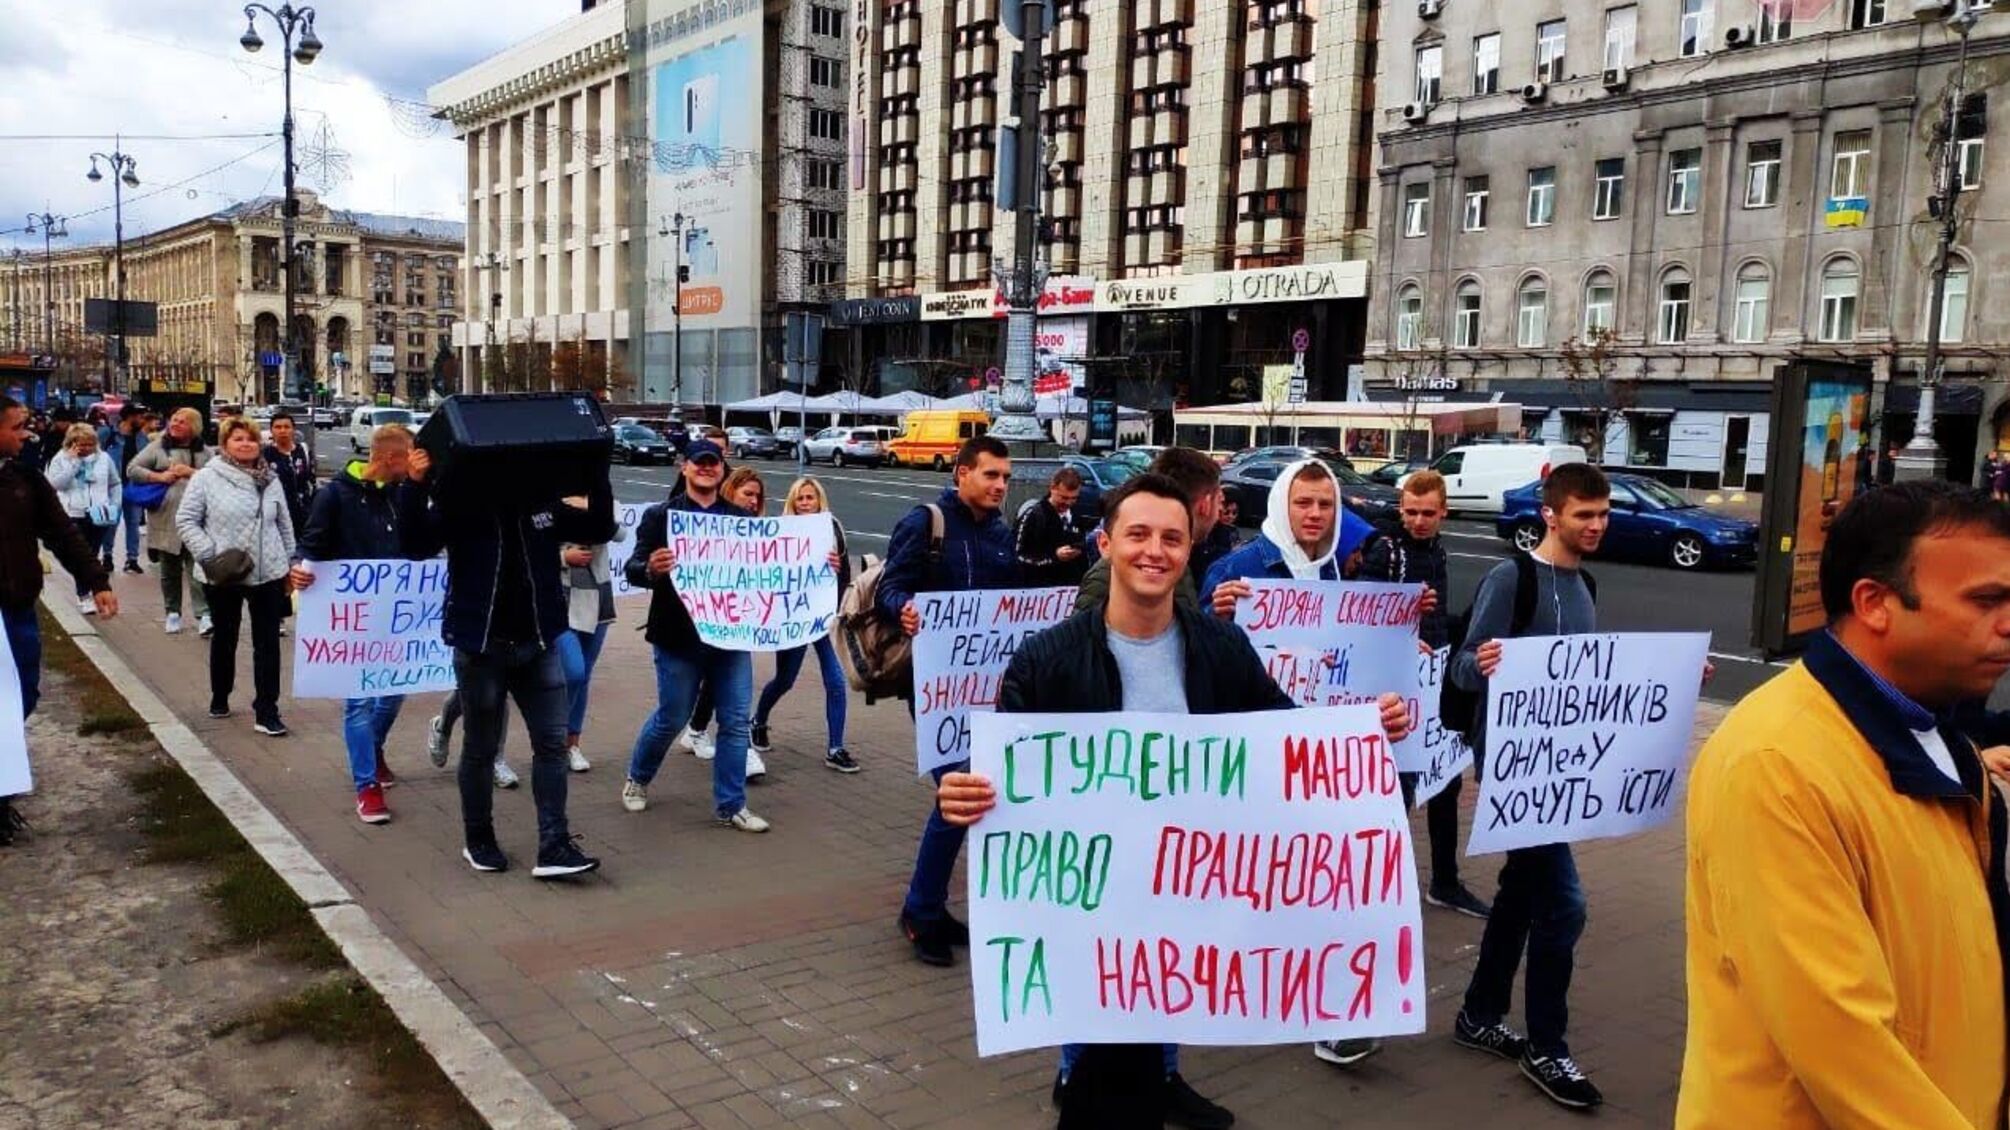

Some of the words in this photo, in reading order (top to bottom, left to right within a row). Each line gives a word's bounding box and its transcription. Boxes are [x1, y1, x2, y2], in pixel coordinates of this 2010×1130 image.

[1106, 282, 1178, 304] AVENUE
[1242, 270, 1339, 299] OTRADA
[671, 511, 779, 537] ВИМАГАЄМО
[676, 537, 810, 564] ПРИПИНИТИ
[331, 602, 370, 632] НЕ
[1247, 588, 1324, 631] ЗОРЯНА
[1547, 635, 1620, 681] СІМЇ
[1497, 679, 1669, 731] ПРАЦІВНИКІВ
[1004, 729, 1247, 803] СТУДЕНТИ
[1283, 734, 1397, 802] МАЮТЬ
[1488, 778, 1602, 832] ХОЧУТЬ
[1617, 767, 1676, 815] ЇСТИ
[980, 831, 1112, 911] ПРАВО
[1152, 825, 1403, 912] ПРАЦЮВАТИ
[986, 936, 1053, 1024] ТА
